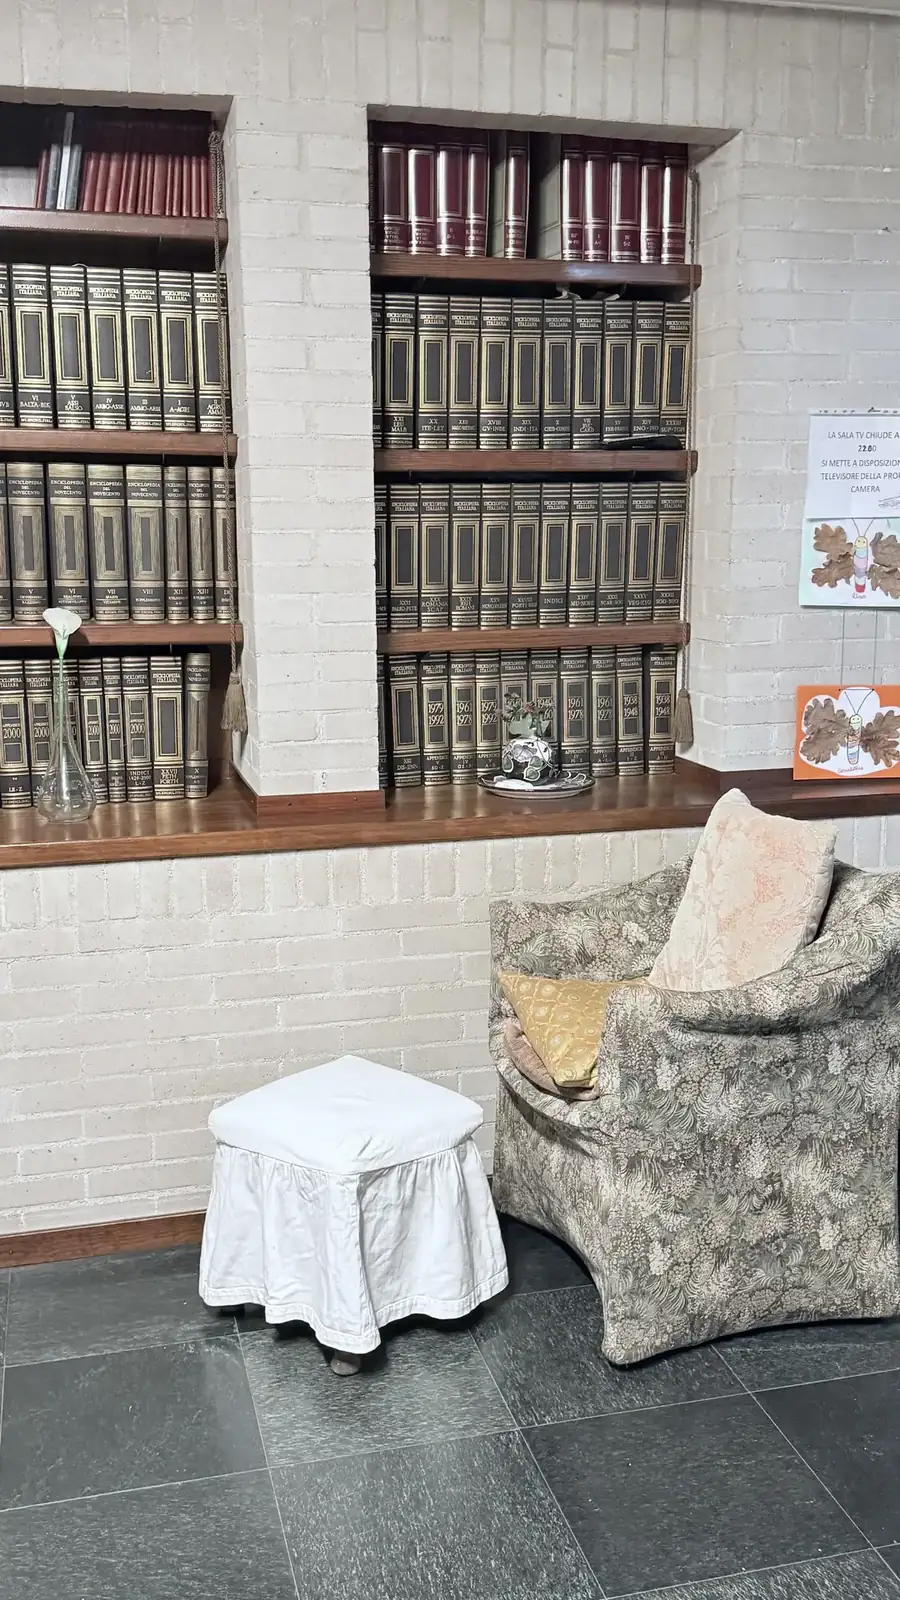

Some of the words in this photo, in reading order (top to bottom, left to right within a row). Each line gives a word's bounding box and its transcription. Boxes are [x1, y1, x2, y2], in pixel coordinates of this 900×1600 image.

[428, 703, 444, 713] 1979
[456, 702, 472, 713] 1961
[482, 702, 496, 712] 1979
[568, 698, 583, 708] 1961
[568, 710, 583, 720] 1978
[624, 707, 638, 717] 1948
[429, 715, 444, 725] 1992
[457, 714, 472, 725] 1978
[482, 714, 497, 724] 1992
[3, 728, 21, 738] 2000
[34, 727, 49, 737] 2000
[130, 723, 145, 733] 2000
